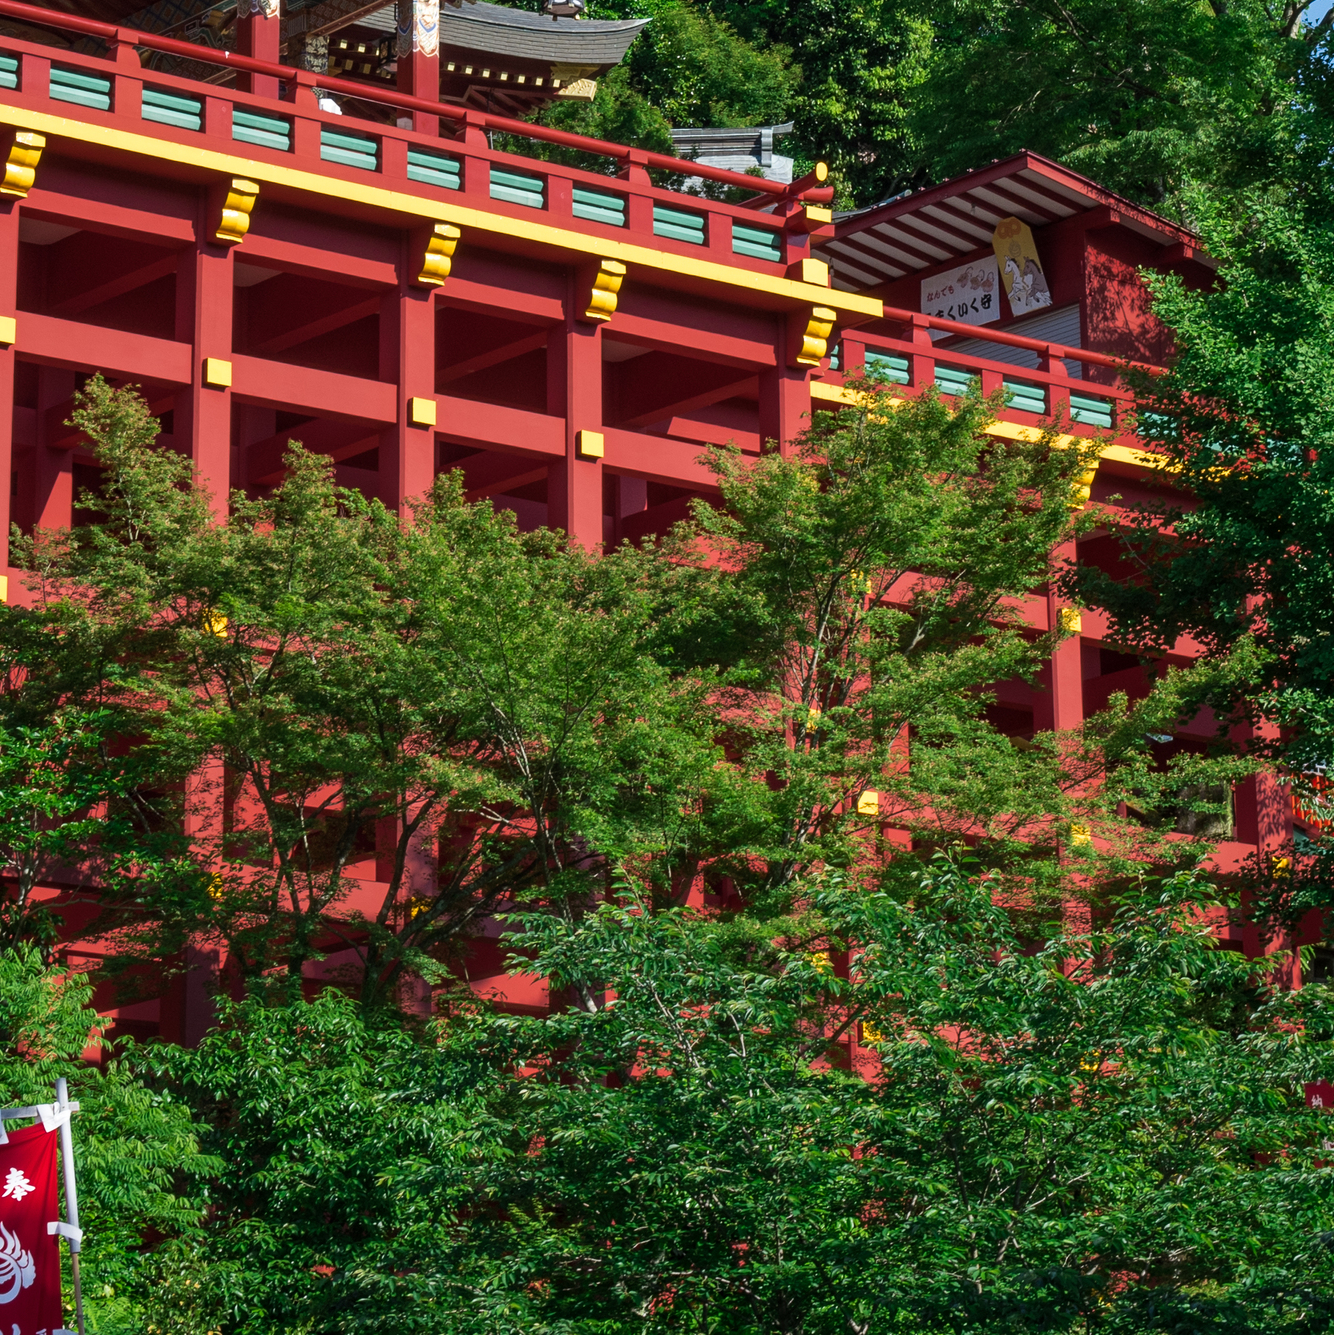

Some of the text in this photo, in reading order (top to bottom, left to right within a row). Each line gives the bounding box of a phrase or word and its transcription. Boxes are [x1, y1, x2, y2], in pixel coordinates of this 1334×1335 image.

[926, 284, 955, 303] なんでも
[925, 293, 993, 321] まくいく守
